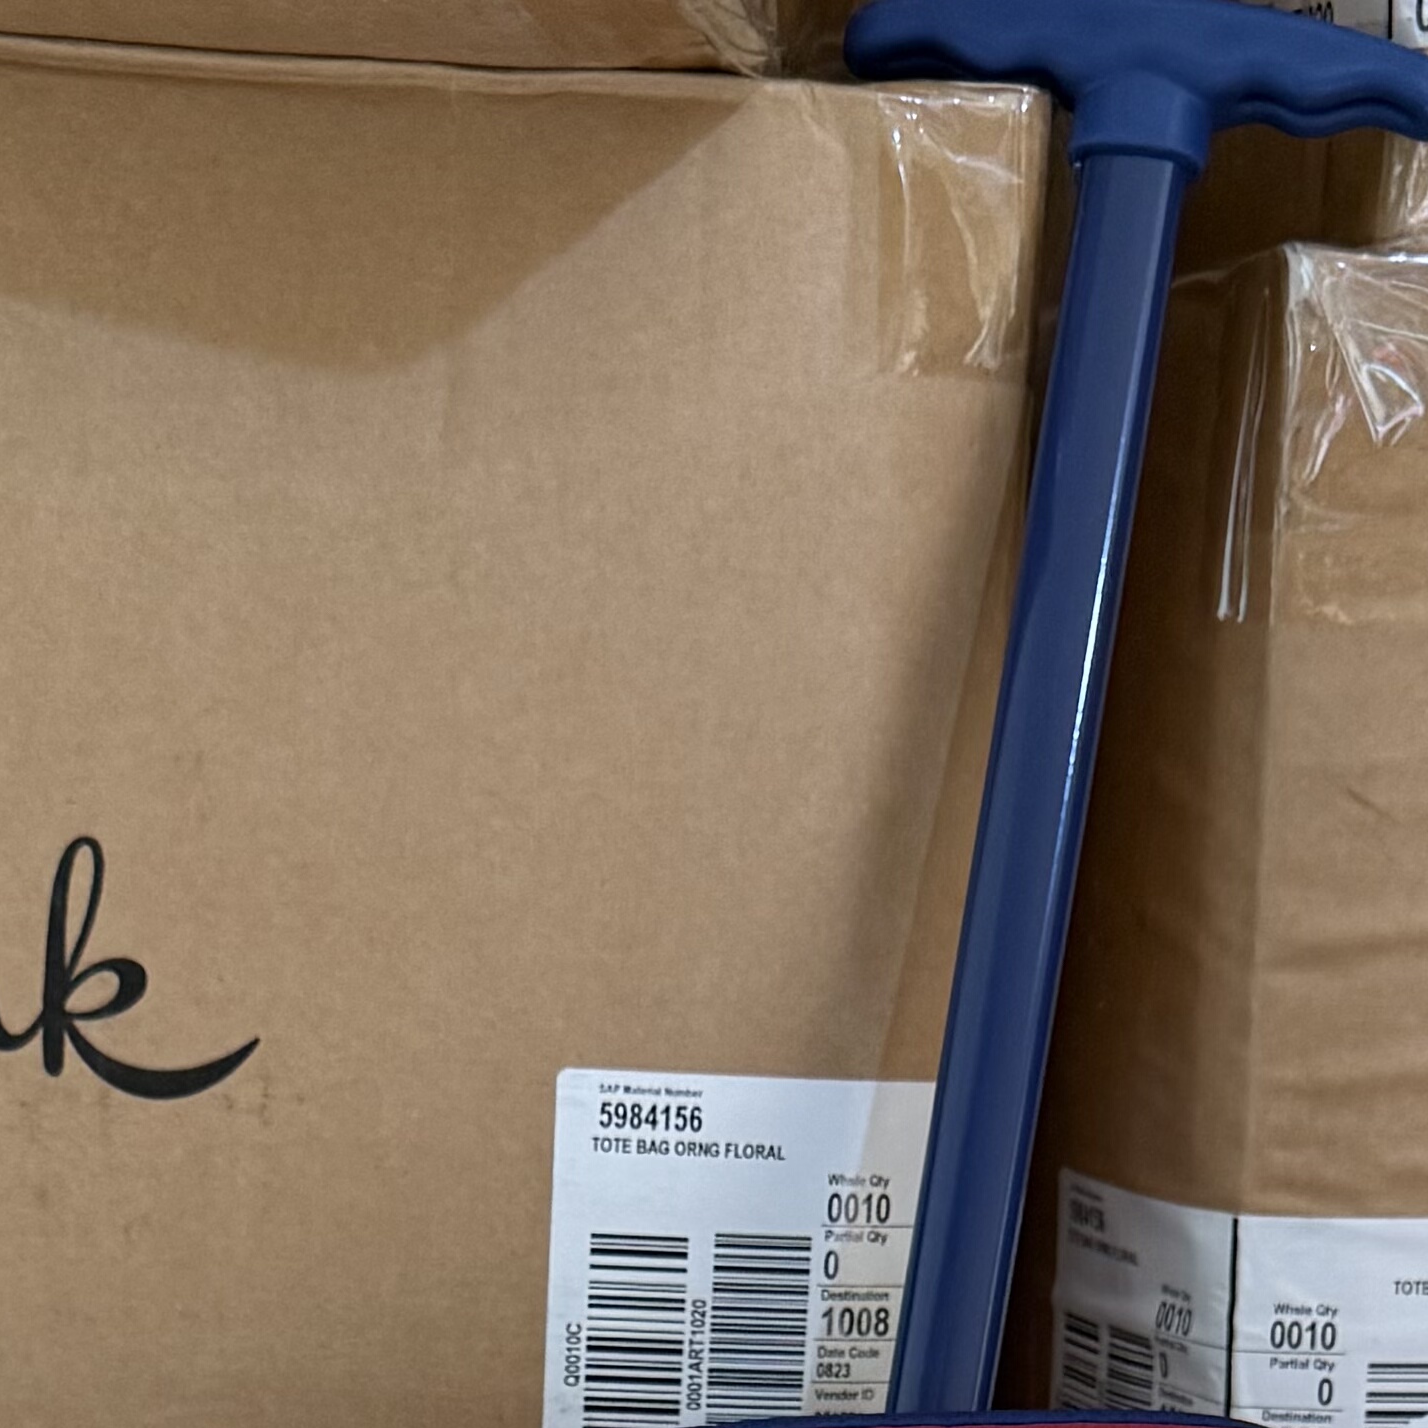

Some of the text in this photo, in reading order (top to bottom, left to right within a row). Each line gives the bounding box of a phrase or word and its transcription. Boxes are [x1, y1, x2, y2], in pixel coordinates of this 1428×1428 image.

[598, 1101, 703, 1133] 5984156
[592, 1136, 786, 1161] TOTE BAG ORNG FLORAL
[869, 1174, 890, 1190] Qty
[827, 1192, 891, 1224] 0010
[866, 1230, 888, 1245] Qty
[823, 1250, 839, 1280] 0
[821, 1289, 890, 1303] Destination
[821, 1307, 890, 1338] 1008
[1156, 1301, 1192, 1337] 0010
[1273, 1303, 1339, 1319] Whole Qty
[1270, 1321, 1337, 1351] 0010
[687, 1299, 707, 1411] 0001ART1020
[817, 1347, 880, 1360] Date Code
[1269, 1358, 1335, 1373] Partial Qty
[816, 1363, 851, 1379] 0823
[1317, 1378, 1334, 1407] 0
[1261, 1410, 1333, 1424] Destination
